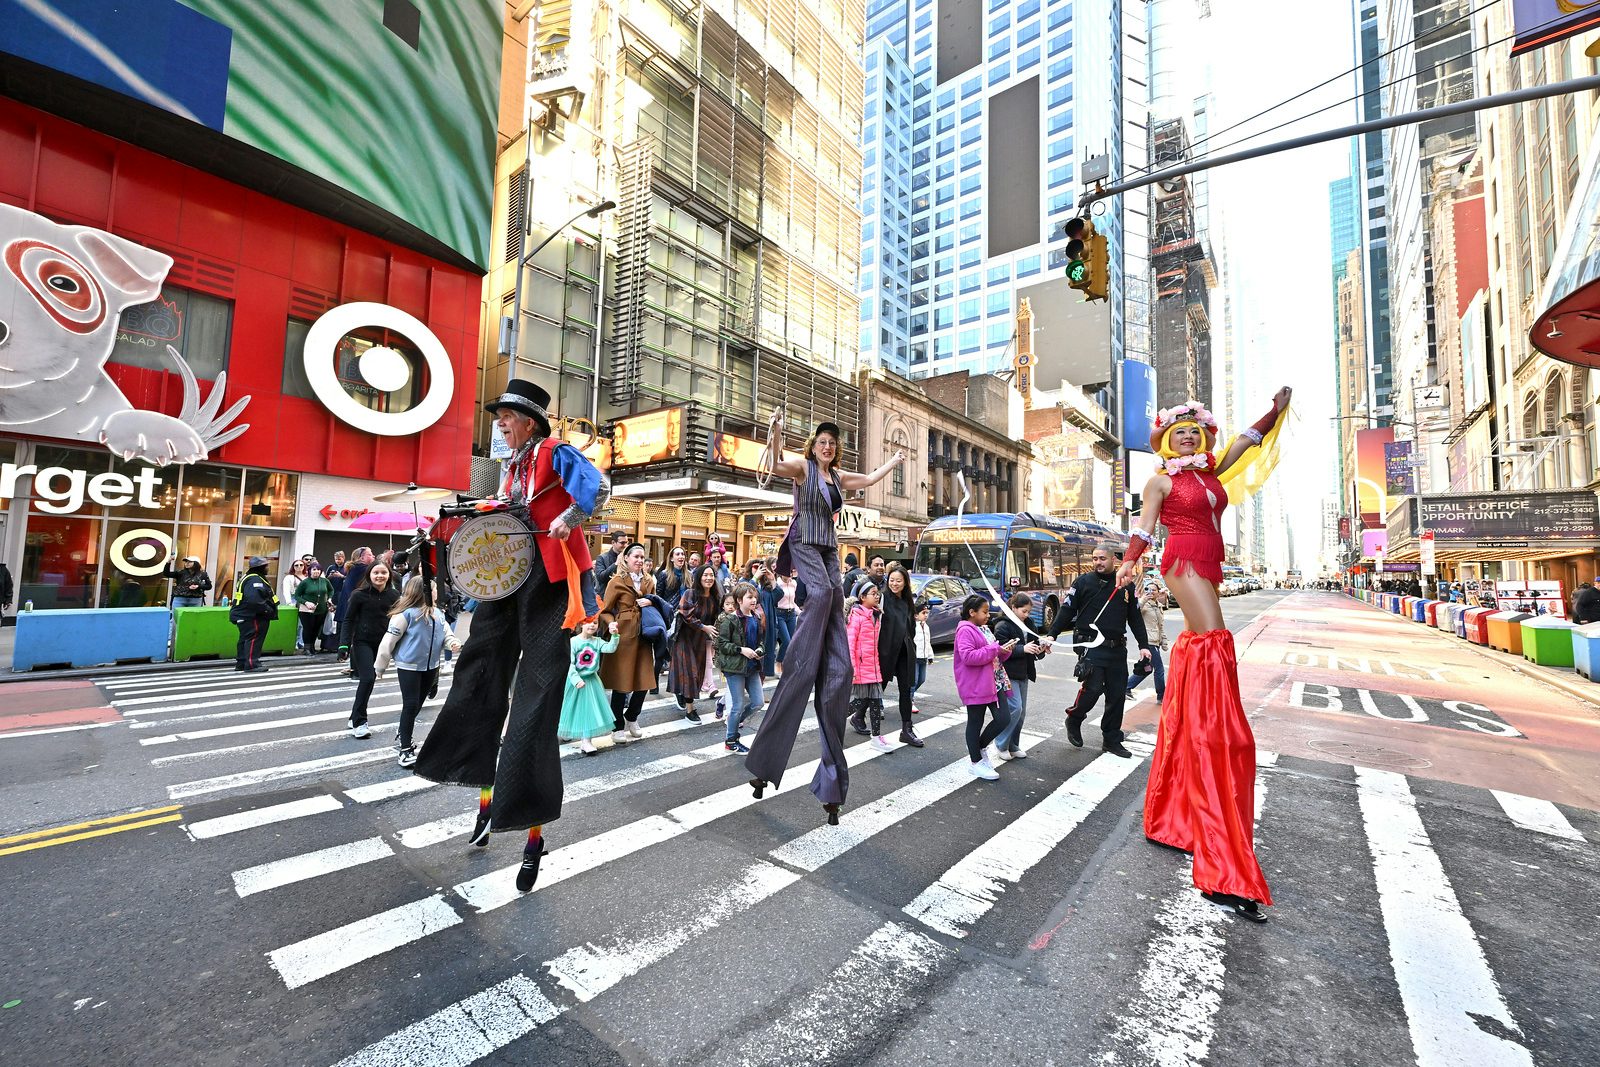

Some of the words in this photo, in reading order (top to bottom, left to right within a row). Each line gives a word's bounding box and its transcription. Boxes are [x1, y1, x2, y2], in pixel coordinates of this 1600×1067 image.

[1115, 461, 1124, 493] VICTORY
[835, 509, 862, 532] NY
[1421, 503, 1464, 512] RETAIL
[1478, 501, 1530, 510] OFFICE
[1422, 511, 1516, 521] OPPORTUNITY
[1534, 507, 1595, 515] 212-372-2430
[455, 544, 464, 558] The
[482, 521, 496, 529] The
[949, 529, 995, 541] CROSSTOWN
[456, 549, 502, 574] SHINBONE
[503, 538, 528, 556] ALLEY
[466, 579, 498, 596] STILT
[501, 557, 529, 590] BAND
[1286, 651, 1454, 683] ONLY
[1287, 681, 1523, 738] BUS
